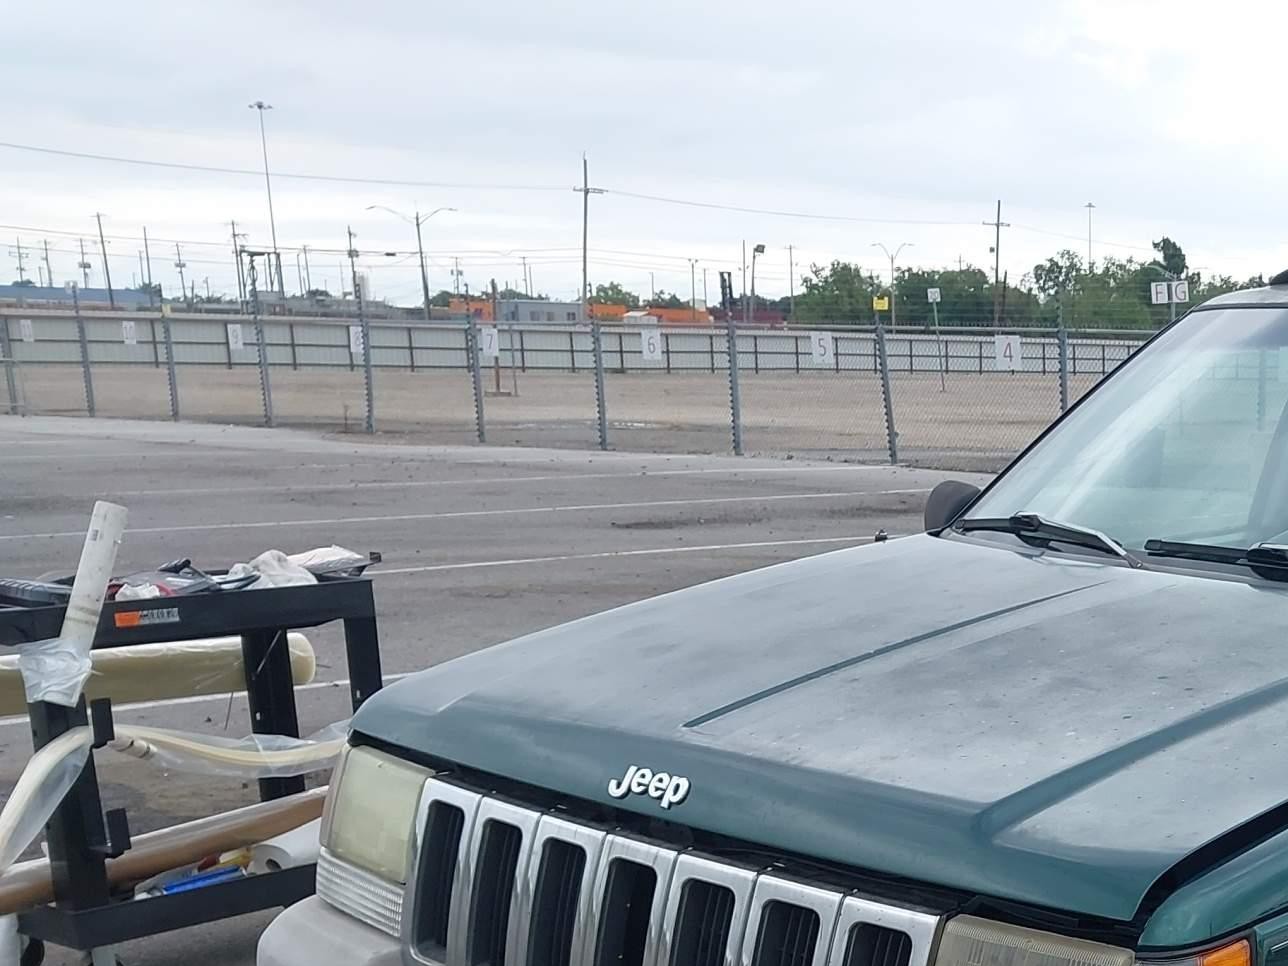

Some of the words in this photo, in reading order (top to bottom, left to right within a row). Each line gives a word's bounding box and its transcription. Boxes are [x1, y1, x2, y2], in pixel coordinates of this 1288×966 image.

[1155, 283, 1164, 301] F
[1175, 282, 1187, 301] G
[486, 333, 494, 349] 7
[647, 336, 656, 353] 6
[818, 337, 827, 356] 5
[1003, 342, 1013, 362] 4
[608, 765, 690, 809] Jeep
